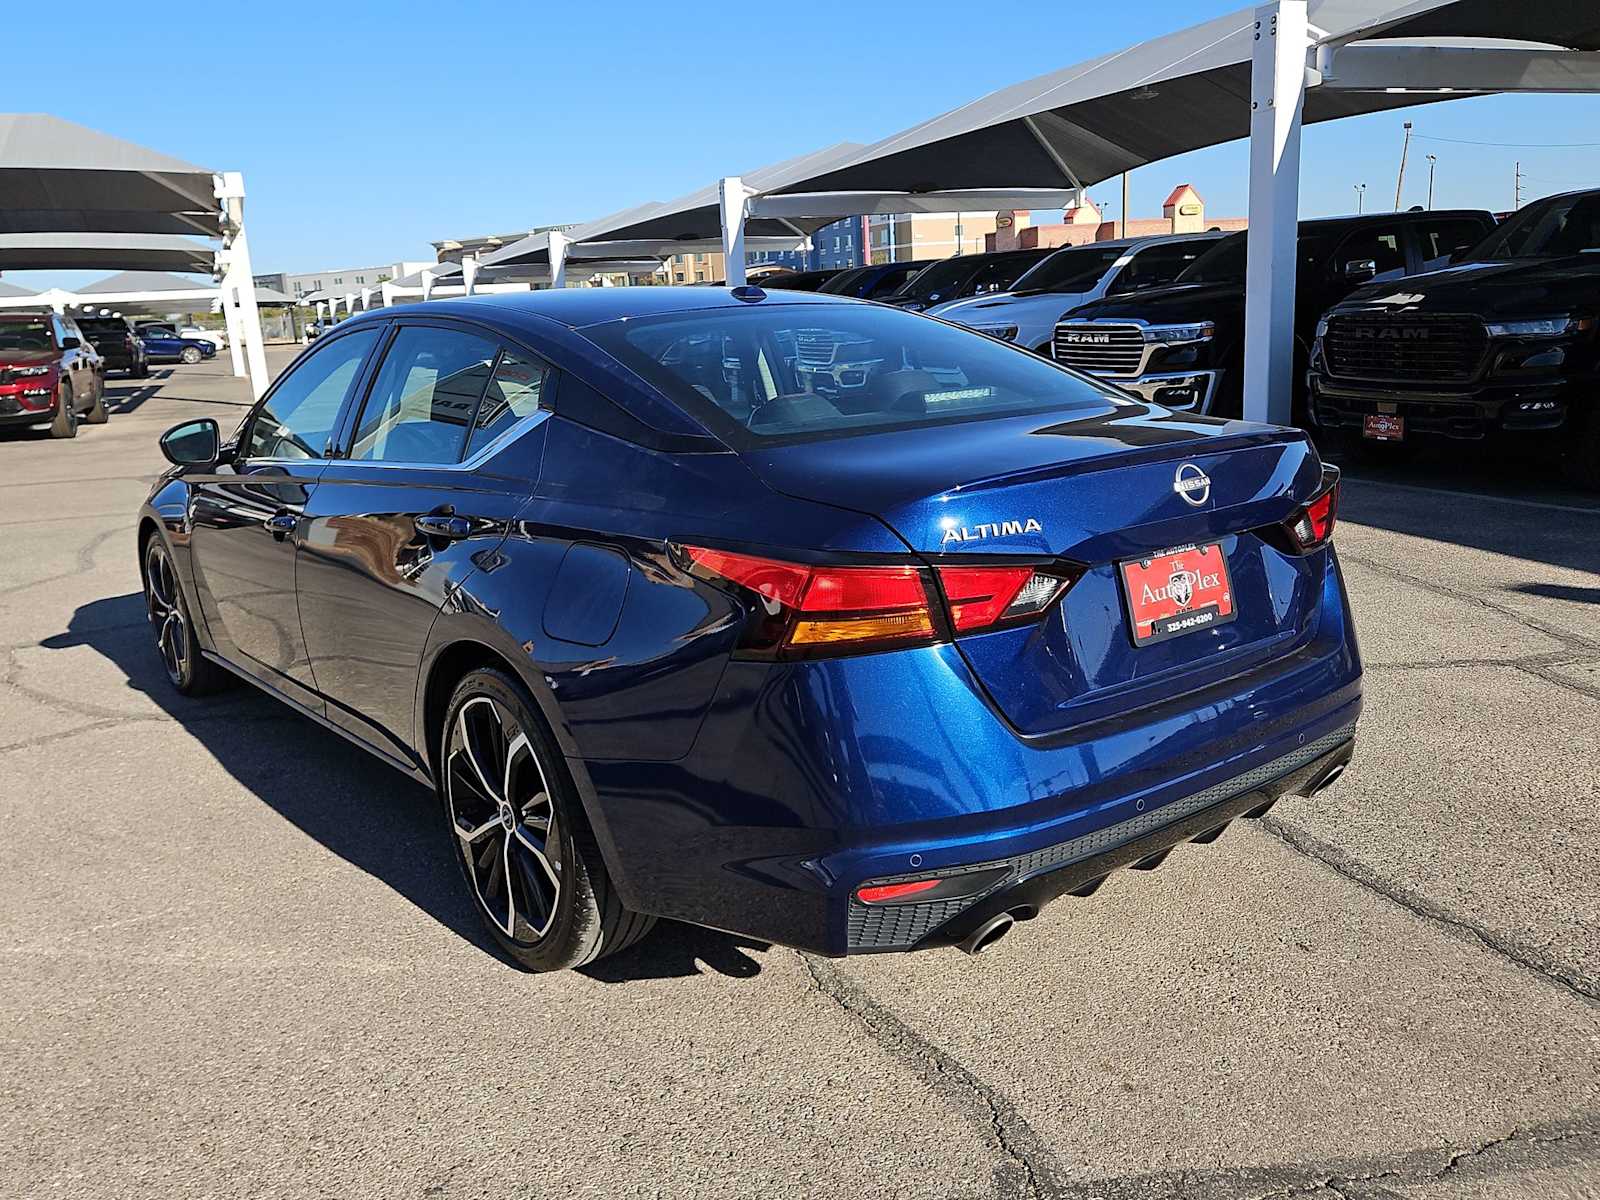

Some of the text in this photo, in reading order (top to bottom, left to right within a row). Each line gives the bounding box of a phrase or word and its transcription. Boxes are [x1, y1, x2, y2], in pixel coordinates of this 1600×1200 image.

[1067, 333, 1110, 343] RAM
[1356, 327, 1430, 339] RAM
[1174, 476, 1211, 492] NISSAN
[941, 518, 1042, 544] ALTIMA
[1169, 560, 1185, 571] The
[1167, 612, 1213, 633] 325-942-6200
